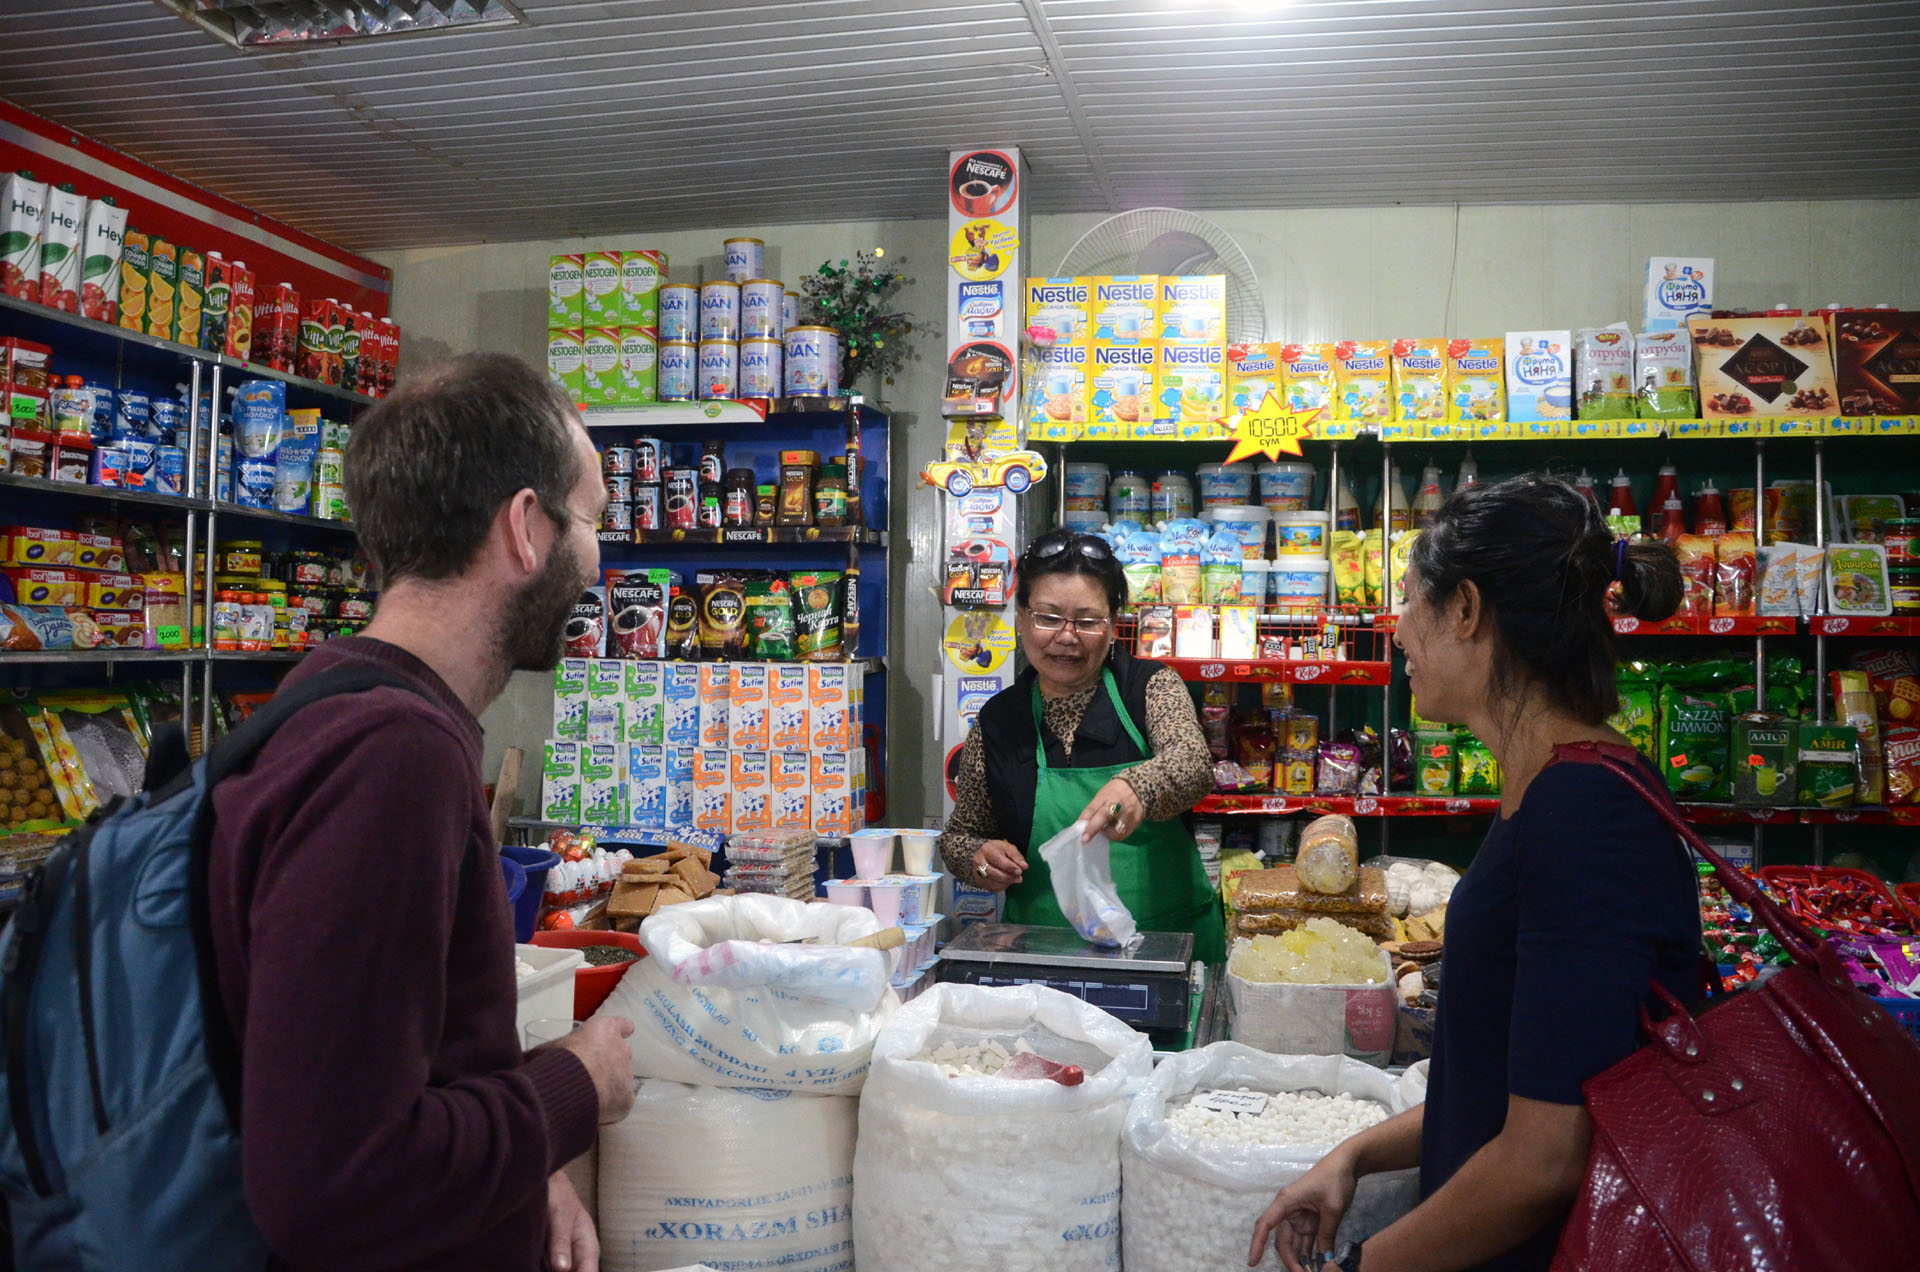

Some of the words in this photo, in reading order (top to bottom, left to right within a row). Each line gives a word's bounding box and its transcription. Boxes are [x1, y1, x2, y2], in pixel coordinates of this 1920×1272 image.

[12, 199, 43, 222] Hey
[51, 211, 81, 234] Hey
[98, 224, 124, 246] Hey
[725, 255, 747, 265] NAN
[551, 271, 583, 281] NESTOGEN
[585, 267, 618, 278] NESTOGEN
[622, 267, 656, 278] NESTOGEN
[234, 281, 254, 296] Vitta
[962, 283, 998, 296] Nestlé
[1031, 285, 1088, 303] Nestlé
[1098, 283, 1156, 301] Nestlé
[662, 300, 689, 311] NAN
[702, 299, 731, 310] NAN
[743, 296, 769, 308] NAN
[254, 302, 282, 319] Vitta
[302, 325, 325, 346] Vitta
[361, 328, 379, 341] Vitta
[380, 335, 399, 348] Vitta
[550, 345, 582, 357] NESTOGEN
[584, 344, 617, 356] NESTOGEN
[621, 343, 655, 355] NESTOGEN
[786, 344, 820, 358] NAN
[1163, 346, 1223, 364] Nestlé
[1588, 348, 1631, 361] отруби
[1640, 343, 1686, 357] отруби
[742, 356, 769, 368] NAN
[1096, 347, 1154, 365] Nestlé
[661, 359, 690, 369] NAN
[701, 357, 731, 368] NAN
[1236, 360, 1275, 373] Nestlé
[1290, 362, 1329, 374] Nestlé
[1345, 358, 1385, 370] Nestlé
[1402, 357, 1442, 369] Nestlé
[1457, 357, 1498, 370] Nestlé
[794, 370, 802, 384] 2
[1248, 416, 1298, 438] 10500
[1259, 438, 1281, 447] сум
[1833, 559, 1880, 574] Доширак
[954, 588, 986, 600] NESCAF
[711, 607, 738, 616] GOLD
[565, 671, 585, 680] Sutim
[600, 672, 620, 682] Sutim
[637, 674, 657, 684] Sutim
[676, 677, 697, 686] Sutim
[741, 678, 764, 688] Sutim
[781, 679, 803, 689] Sutim
[821, 679, 843, 689] Sutim
[961, 680, 999, 692] Nestlé
[1750, 733, 1788, 742] AATCO
[554, 754, 576, 764] Sutim
[593, 756, 614, 766] Sutim
[641, 755, 662, 765] Sutim
[704, 762, 726, 772] Sutim
[743, 764, 766, 774] Sutim
[783, 764, 806, 774] Sutim
[823, 765, 845, 774] Sutim
